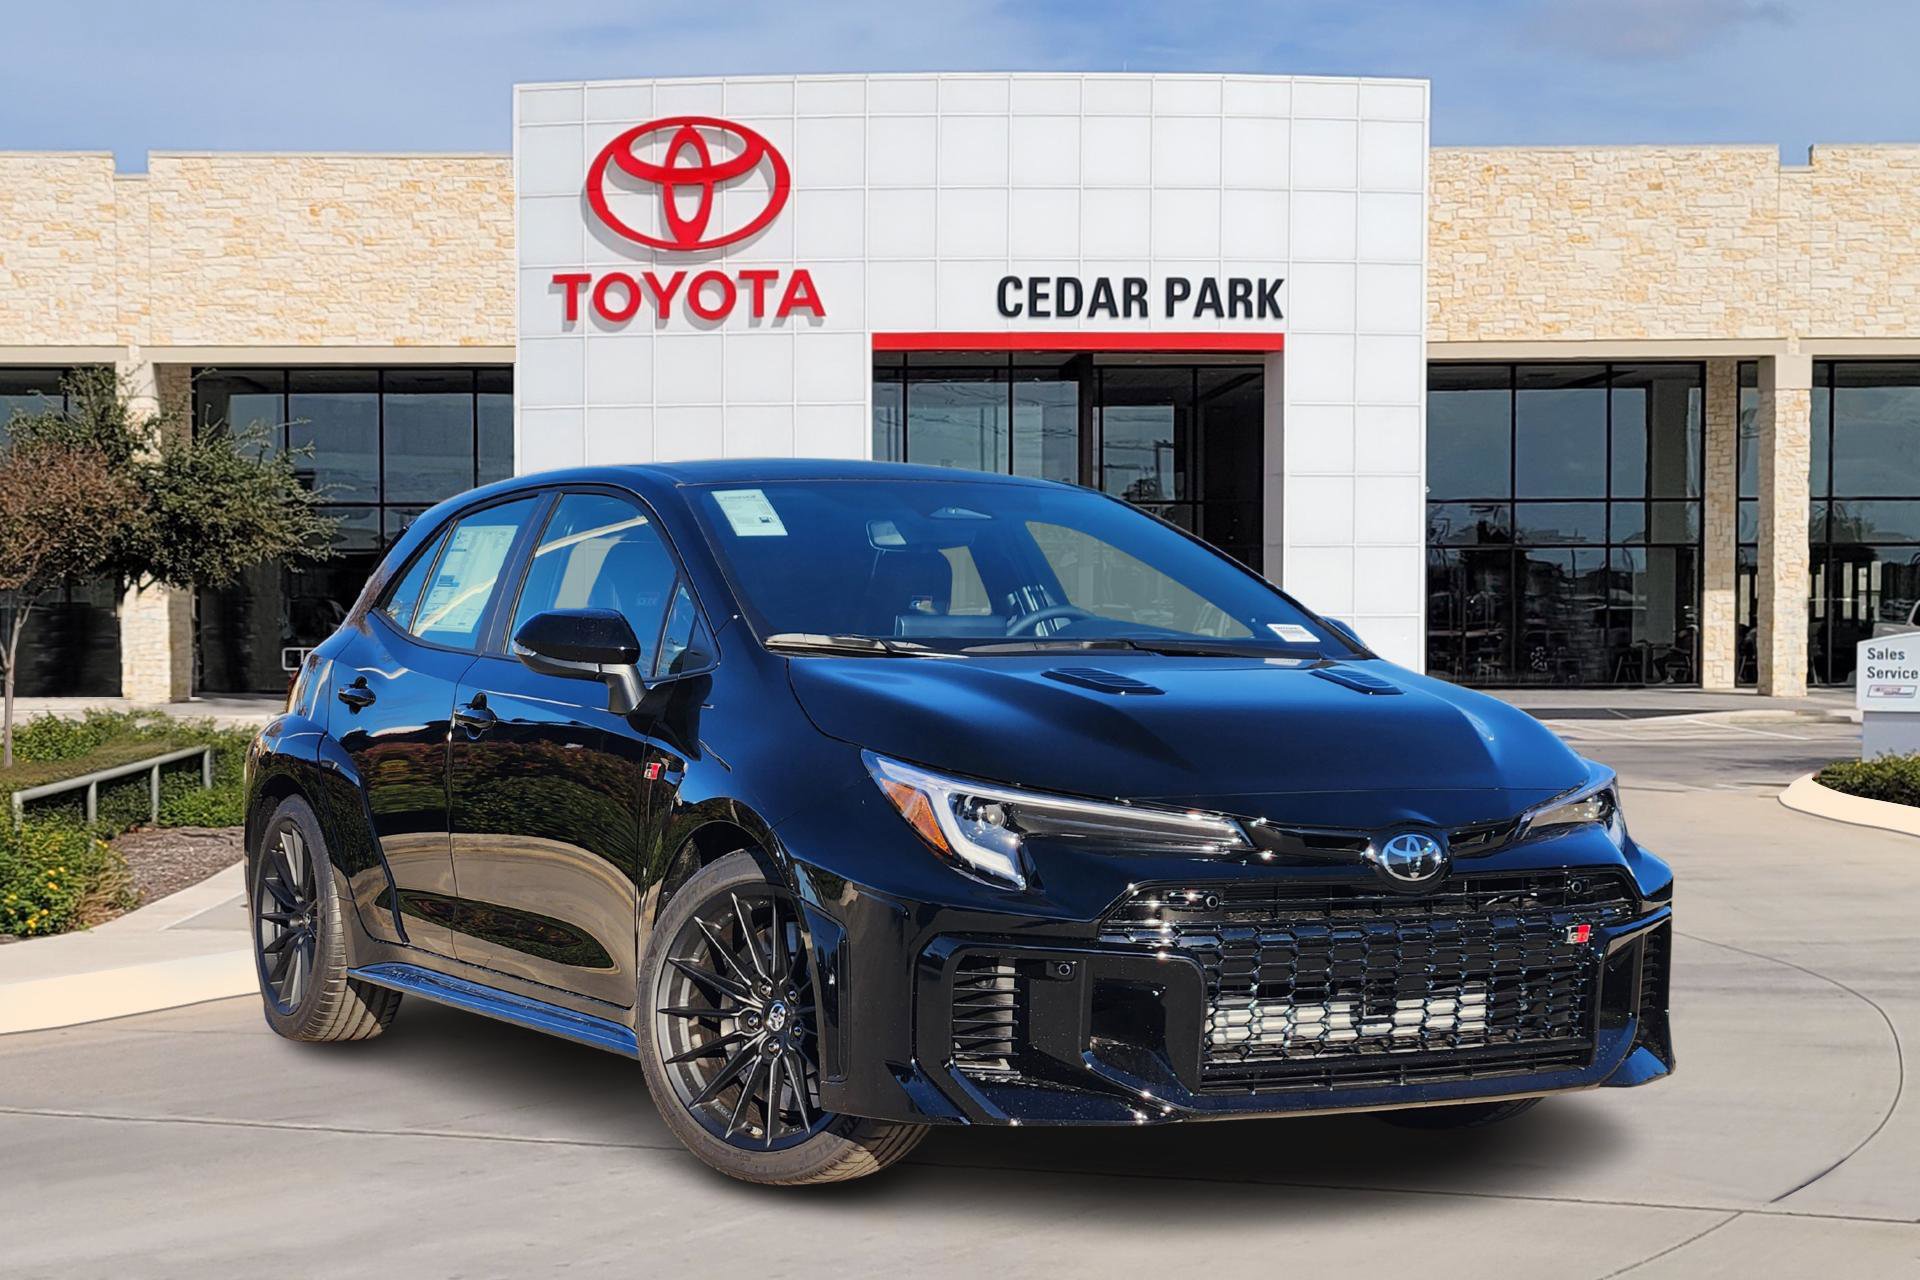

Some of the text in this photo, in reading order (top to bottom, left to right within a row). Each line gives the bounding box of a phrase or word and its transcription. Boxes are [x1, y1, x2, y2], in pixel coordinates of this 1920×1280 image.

[552, 269, 826, 322] TOYOTA
[997, 276, 1285, 319] CEDAR PARK
[1867, 647, 1905, 660] Sales
[1867, 666, 1919, 679] Service
